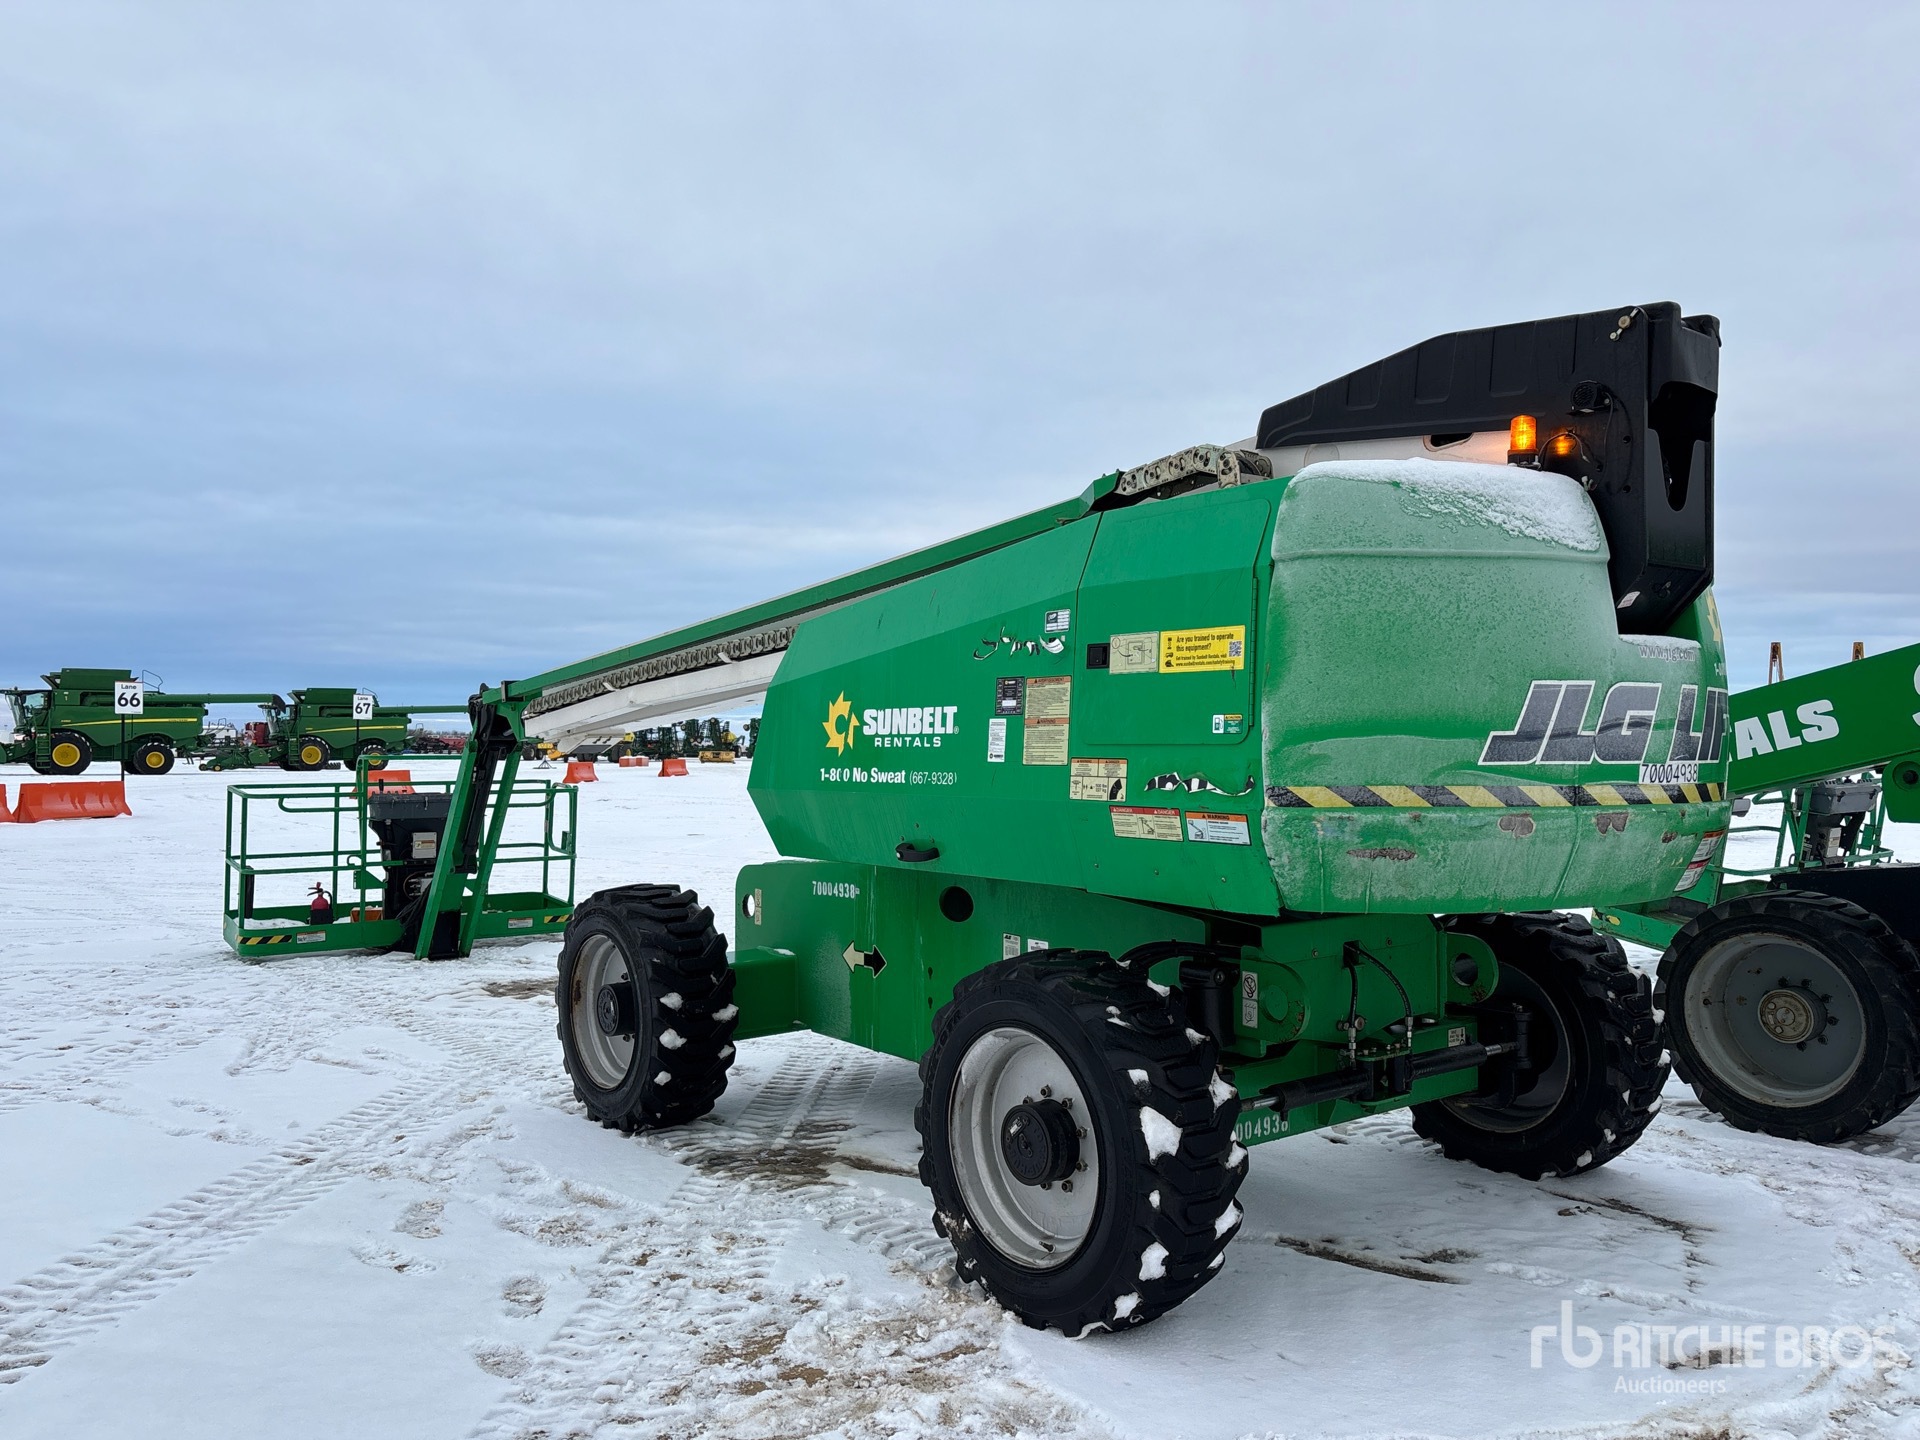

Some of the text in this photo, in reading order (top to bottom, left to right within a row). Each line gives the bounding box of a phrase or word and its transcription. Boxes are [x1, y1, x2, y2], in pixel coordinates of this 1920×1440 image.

[1176, 632, 1234, 644] Are you trained to operate
[1176, 643, 1212, 653] this equipment?
[117, 692, 141, 708] 66
[355, 703, 371, 715] 67
[862, 706, 958, 735] SUNBELT
[1477, 680, 1662, 765] JLG
[1729, 699, 1840, 762] ALS
[874, 737, 942, 748] RENTALS
[852, 767, 868, 783] No
[870, 767, 906, 784] Sweat
[909, 769, 958, 786] (667-9328)
[1641, 763, 1698, 784] 70004938
[811, 880, 855, 899] 70004938
